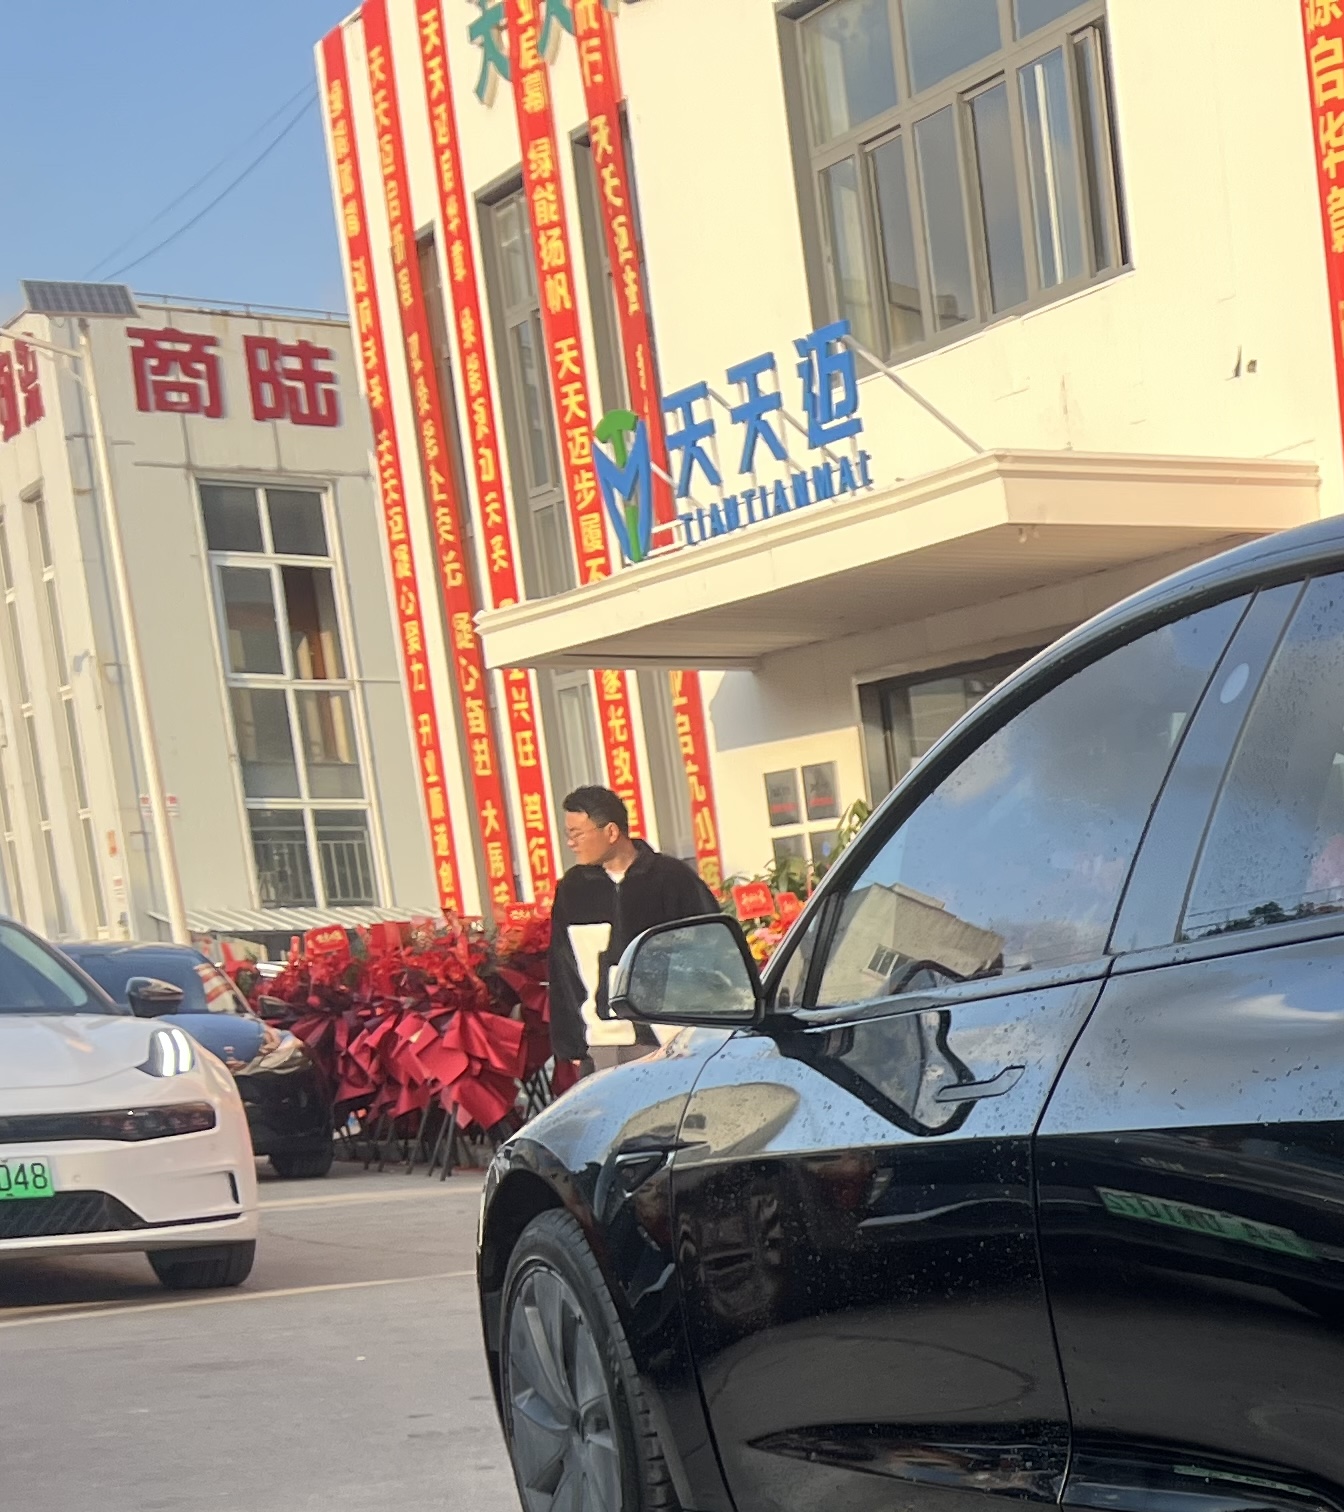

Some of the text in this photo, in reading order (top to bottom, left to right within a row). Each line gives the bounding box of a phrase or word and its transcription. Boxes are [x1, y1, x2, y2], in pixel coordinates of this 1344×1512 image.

[662, 320, 864, 499] 天天迈
[678, 450, 875, 546] TIANTIANMAI
